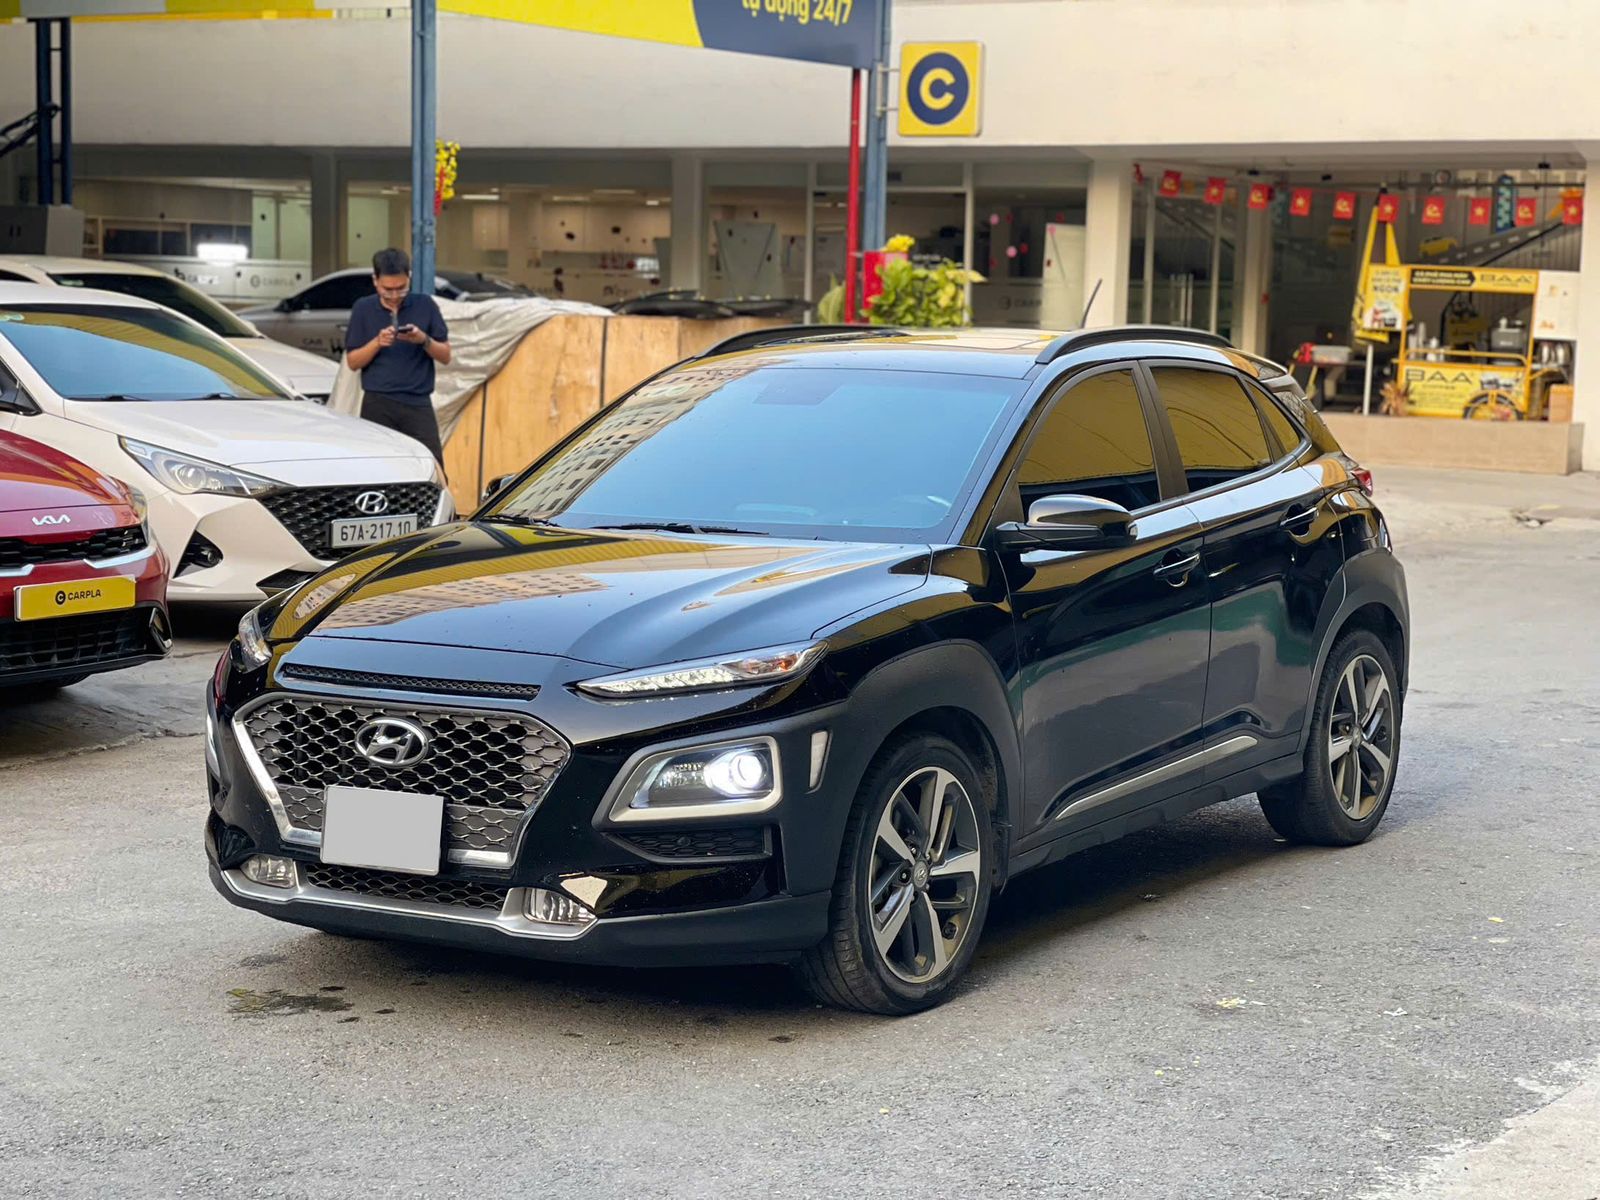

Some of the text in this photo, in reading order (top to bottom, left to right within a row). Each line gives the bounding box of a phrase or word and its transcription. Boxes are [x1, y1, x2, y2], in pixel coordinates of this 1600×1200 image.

[813, 0, 853, 26] 24/7
[920, 67, 956, 111] C
[1406, 368, 1472, 385] BAA
[341, 520, 411, 542] 67A-217.10
[68, 589, 101, 601] CARPLA
